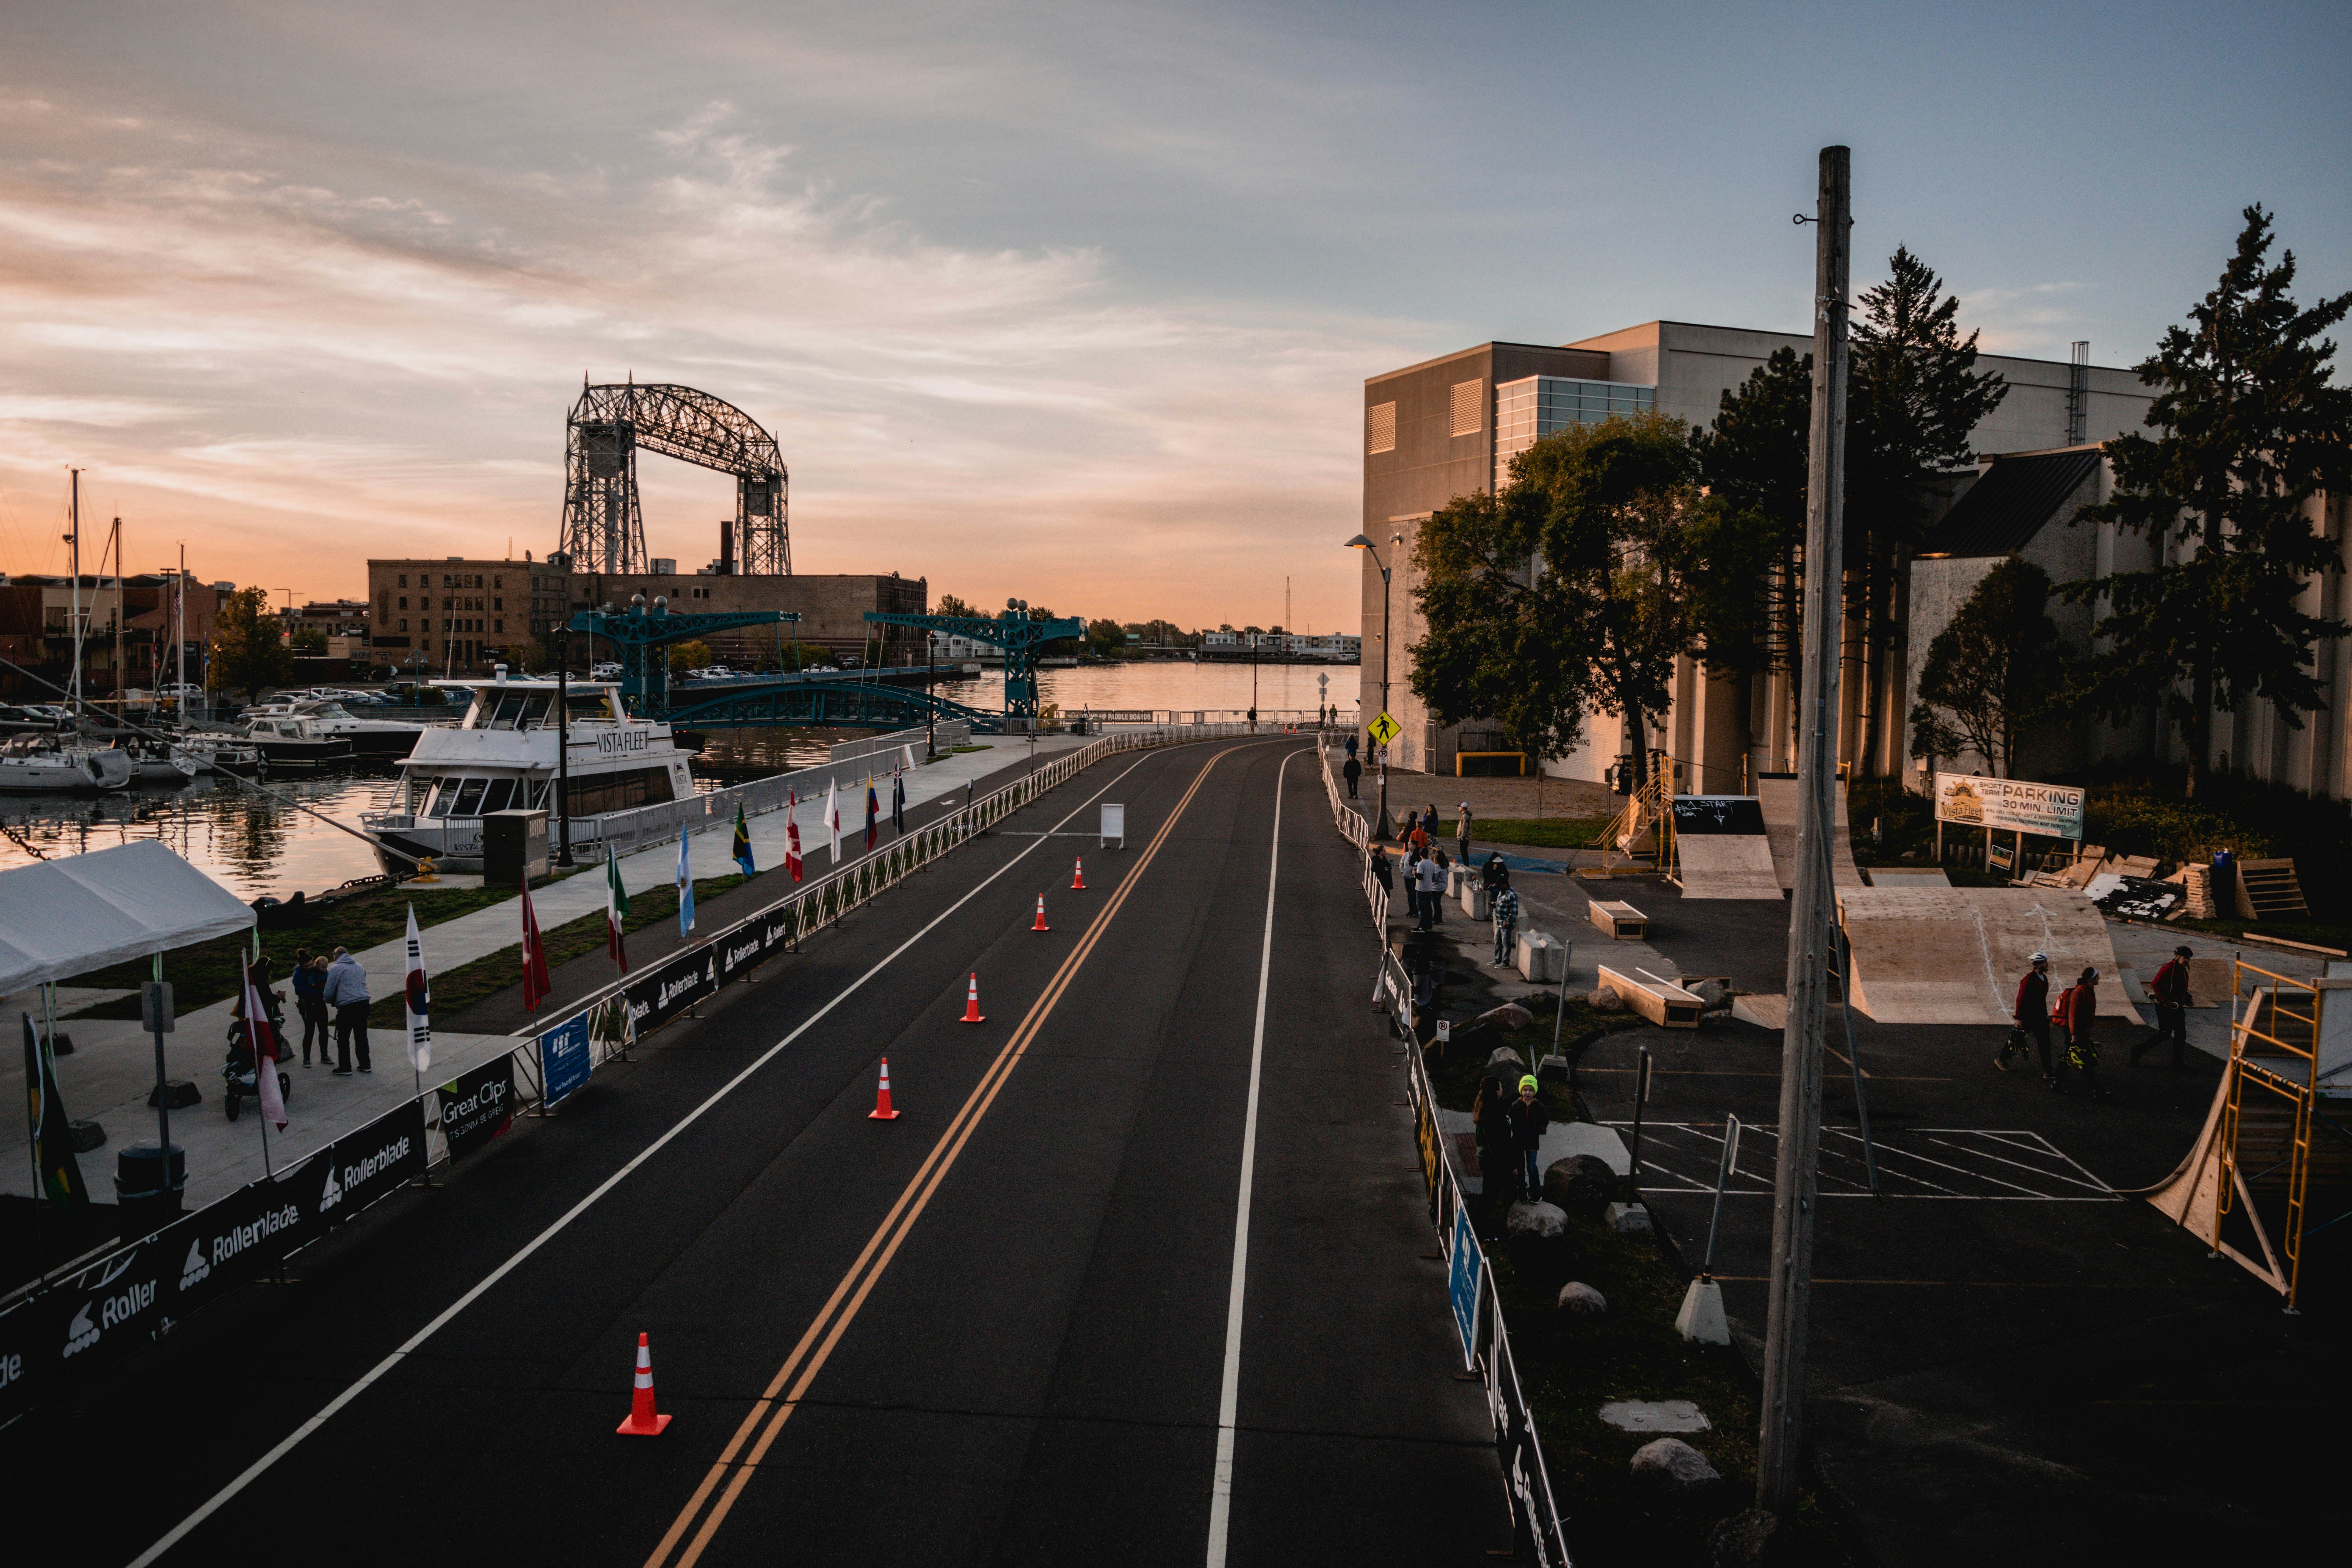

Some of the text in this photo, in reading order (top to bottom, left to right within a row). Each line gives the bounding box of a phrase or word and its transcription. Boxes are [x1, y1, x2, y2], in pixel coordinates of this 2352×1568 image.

[597, 731, 649, 753] VISTA FLEET
[675, 774, 687, 785] VISTA
[2003, 785, 2079, 806] PARKING
[1700, 800, 1735, 815] START
[1942, 805, 1982, 817] Vista Fleet
[2003, 800, 2077, 817] 30 MIN. LIMIT
[733, 938, 760, 964] Rollerblade
[668, 971, 698, 1000] Rollerblade
[443, 1080, 507, 1124] Great Clips
[449, 1103, 505, 1142] IT'S GONNA BE GREAT
[344, 1136, 410, 1192] Rollerblade
